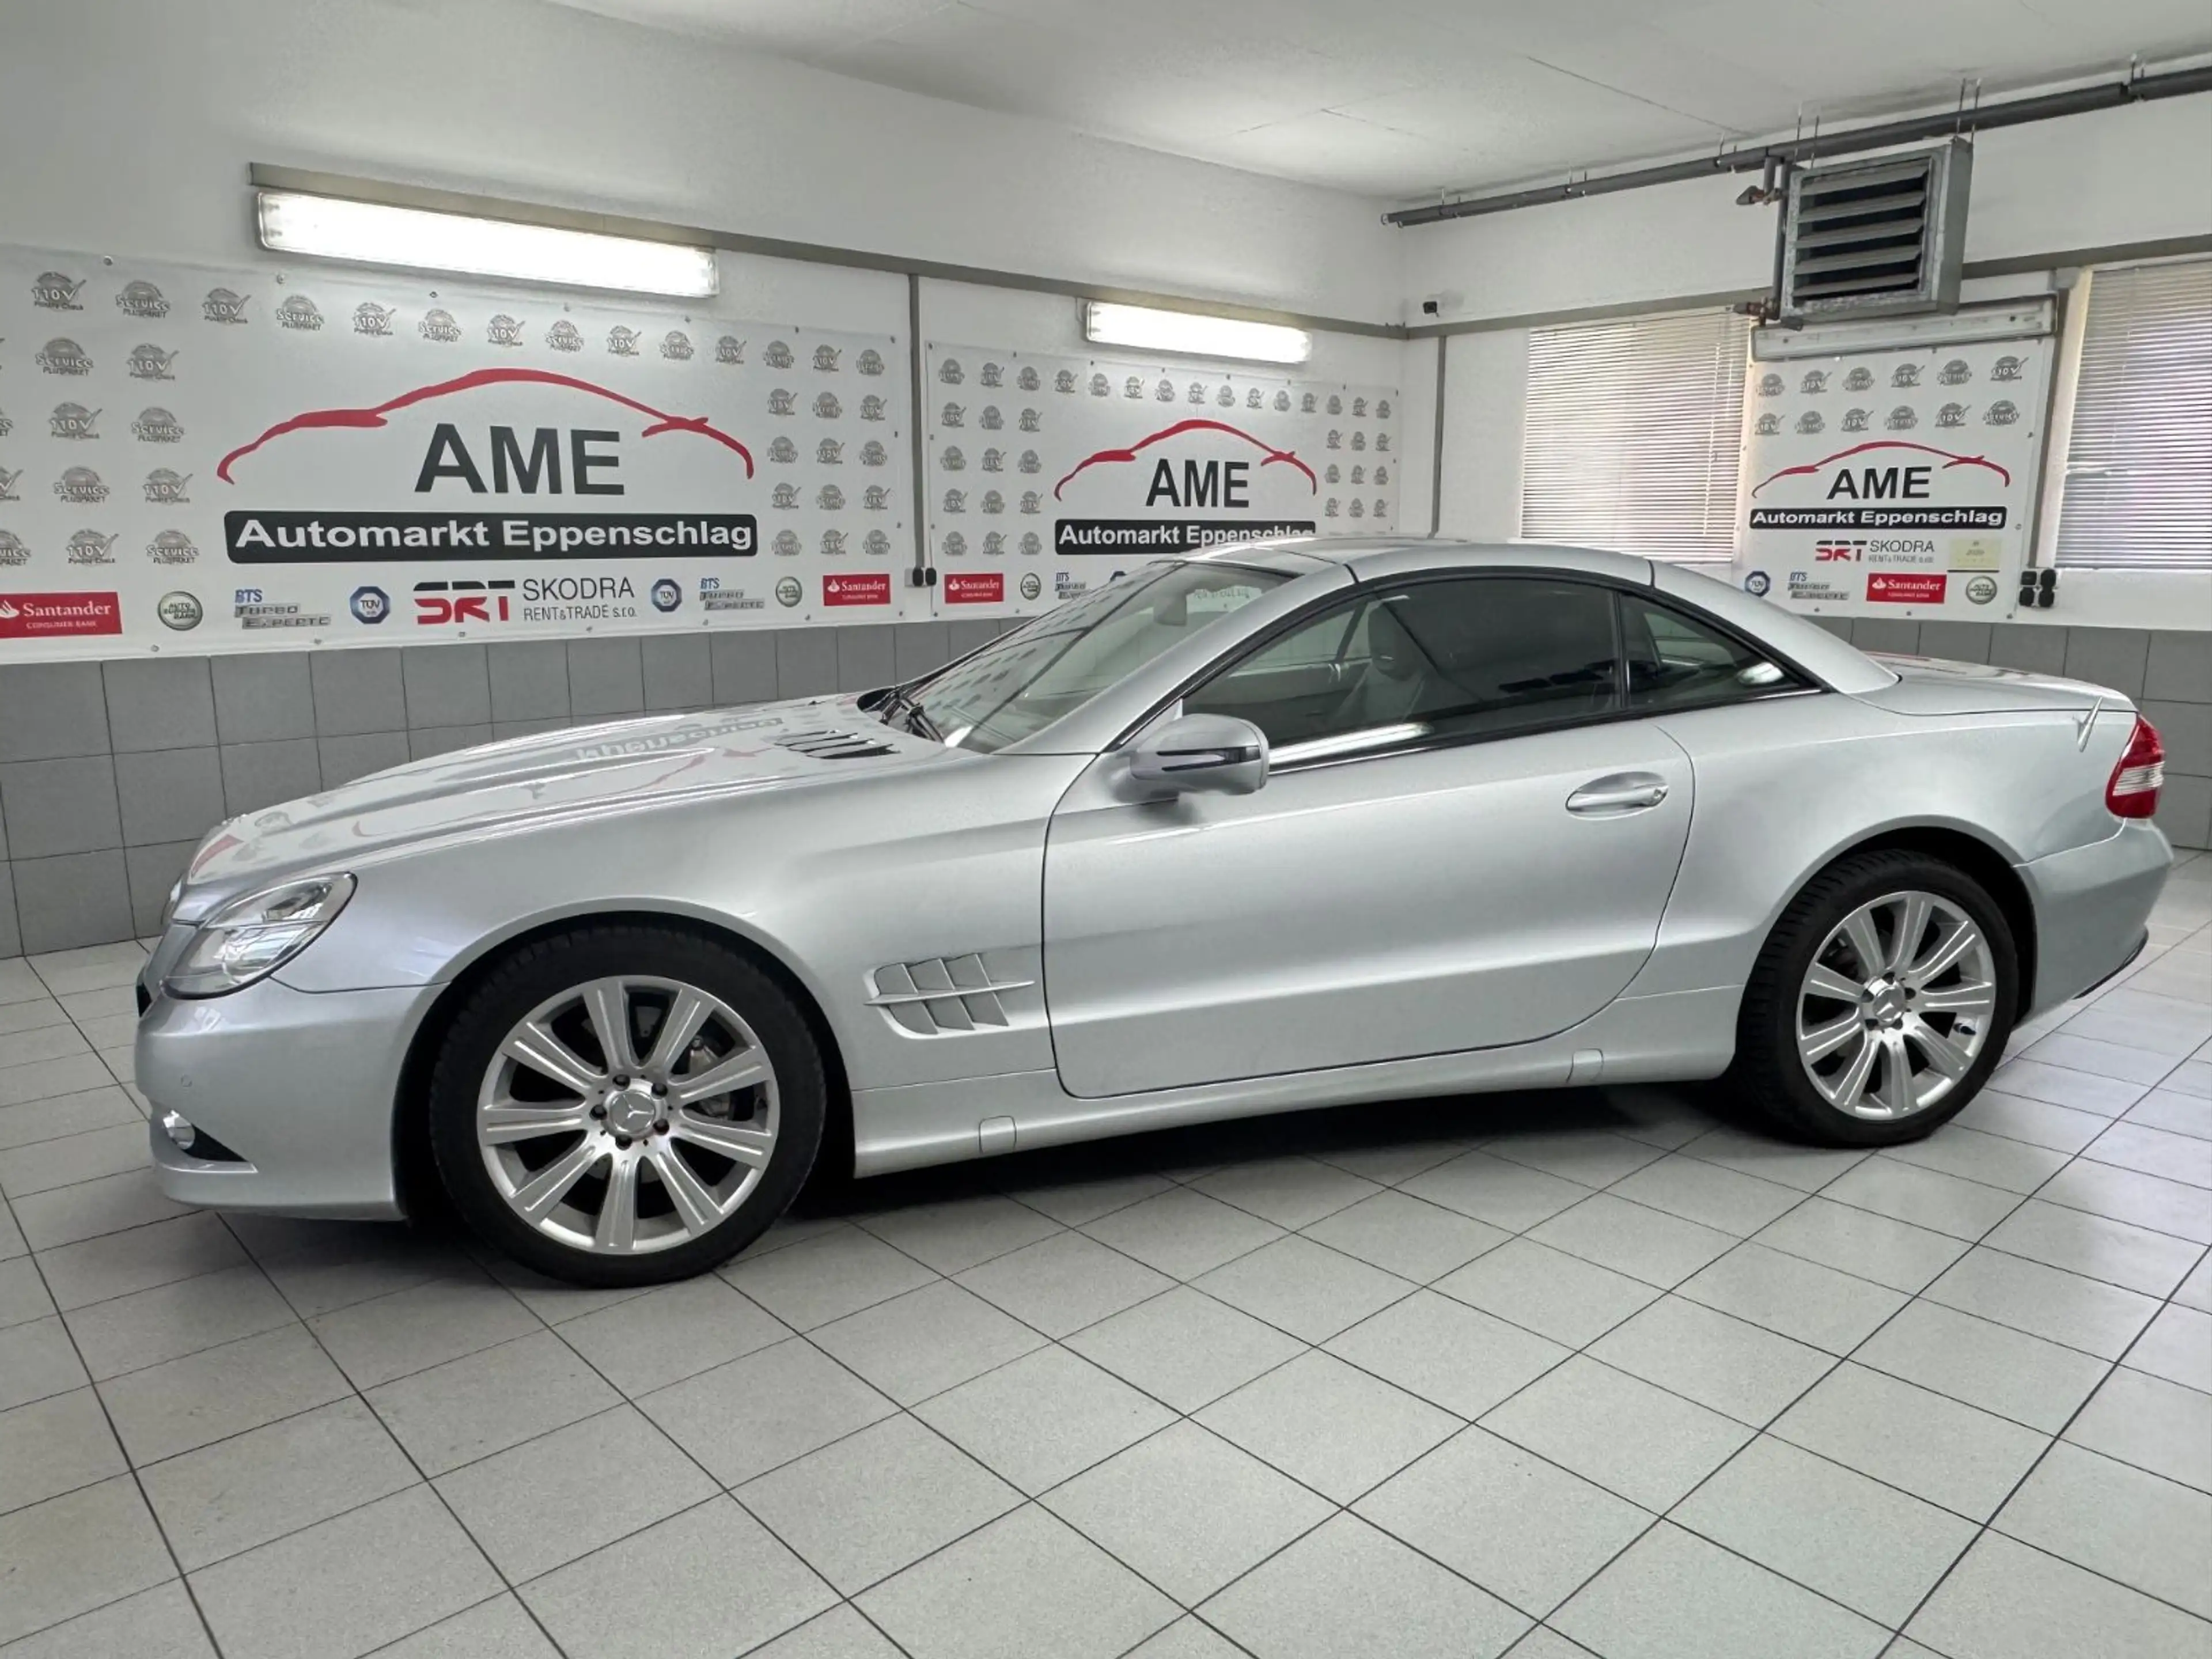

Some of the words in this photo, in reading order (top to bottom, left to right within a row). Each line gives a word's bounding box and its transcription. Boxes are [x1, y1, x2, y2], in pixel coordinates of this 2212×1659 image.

[415, 423, 624, 495] AME
[1145, 459, 1249, 508] AME
[1827, 466, 1932, 500] AME
[1752, 511, 1855, 524] Automarkt
[1861, 510, 2003, 527] Eppenschlag
[236, 518, 490, 549] Automarkt
[503, 519, 752, 552] Eppenschlag
[1059, 524, 1180, 546] Automarkt
[1815, 540, 1868, 562] SRT
[1869, 540, 1936, 553] SKODRA
[522, 577, 635, 601] SKODRA
[841, 581, 886, 592] Santander
[1887, 579, 1941, 590] Santander
[234, 589, 263, 604] BTS
[413, 580, 516, 625] SRT
[22, 601, 111, 618] Santander
